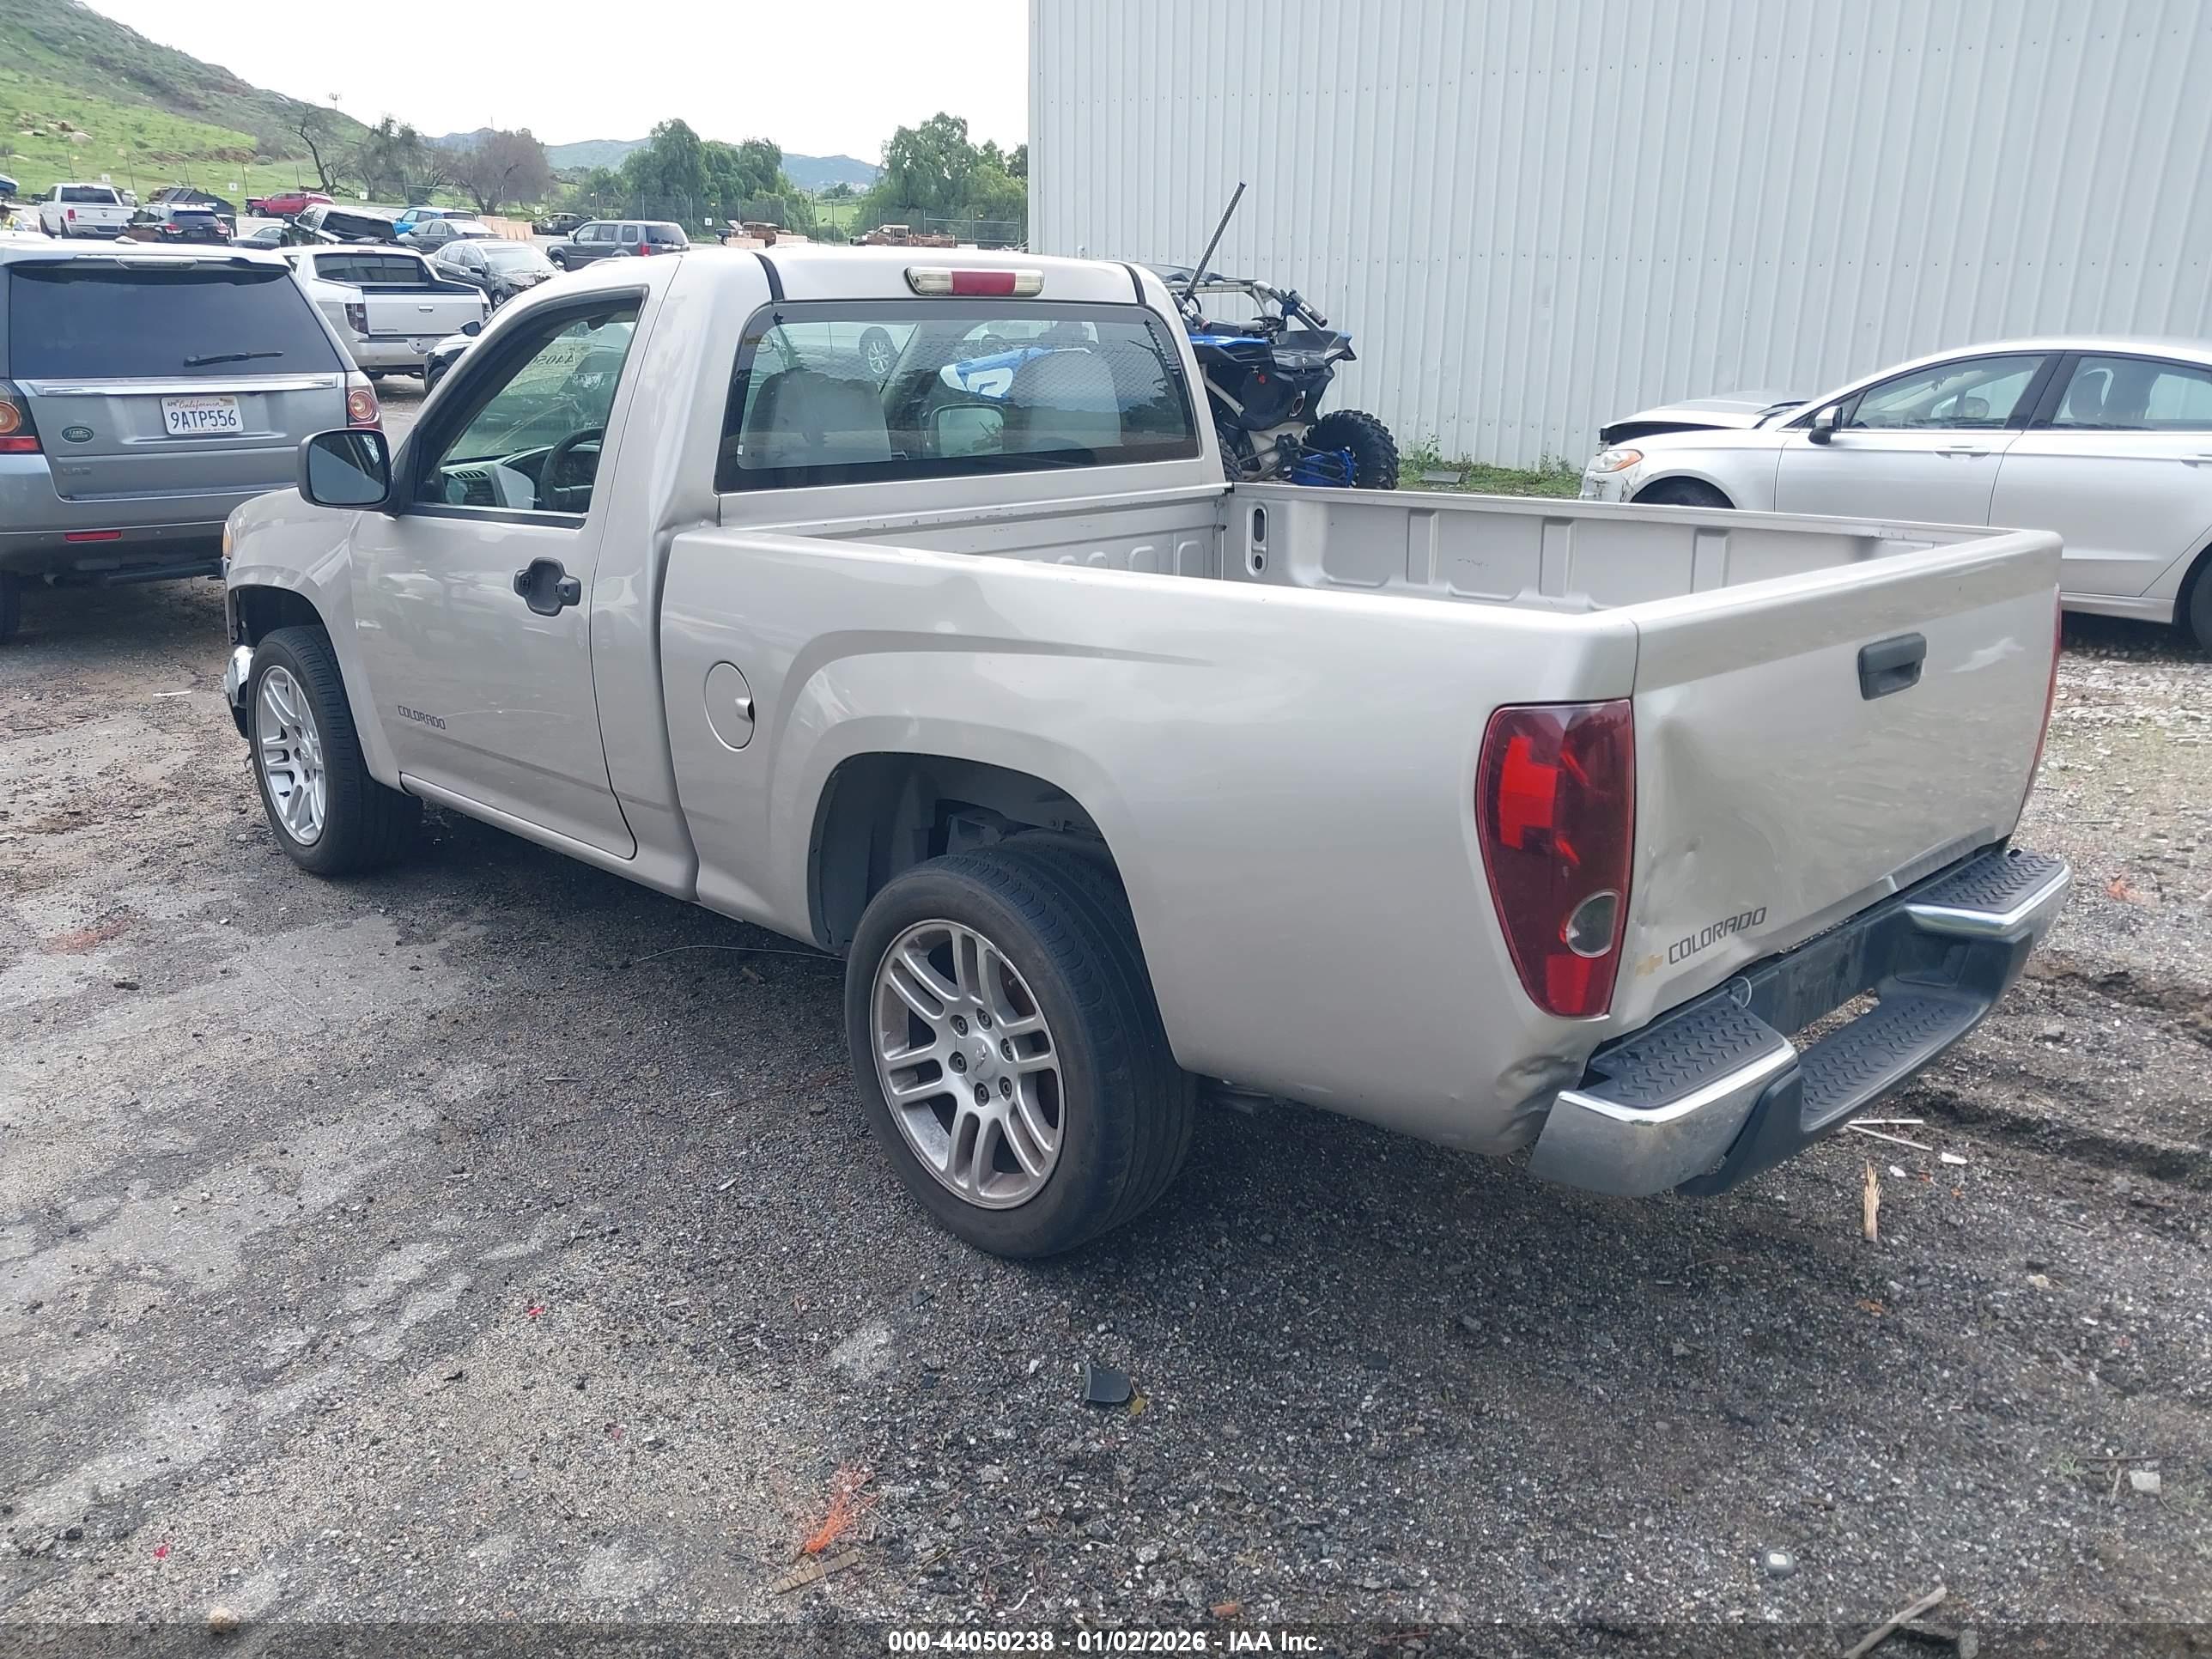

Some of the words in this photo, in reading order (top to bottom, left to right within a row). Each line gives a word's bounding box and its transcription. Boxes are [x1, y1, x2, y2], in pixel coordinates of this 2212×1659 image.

[170, 410, 236, 430] 9ATP556
[398, 705, 447, 730] COLORADO
[1668, 906, 1767, 965] COLORADO
